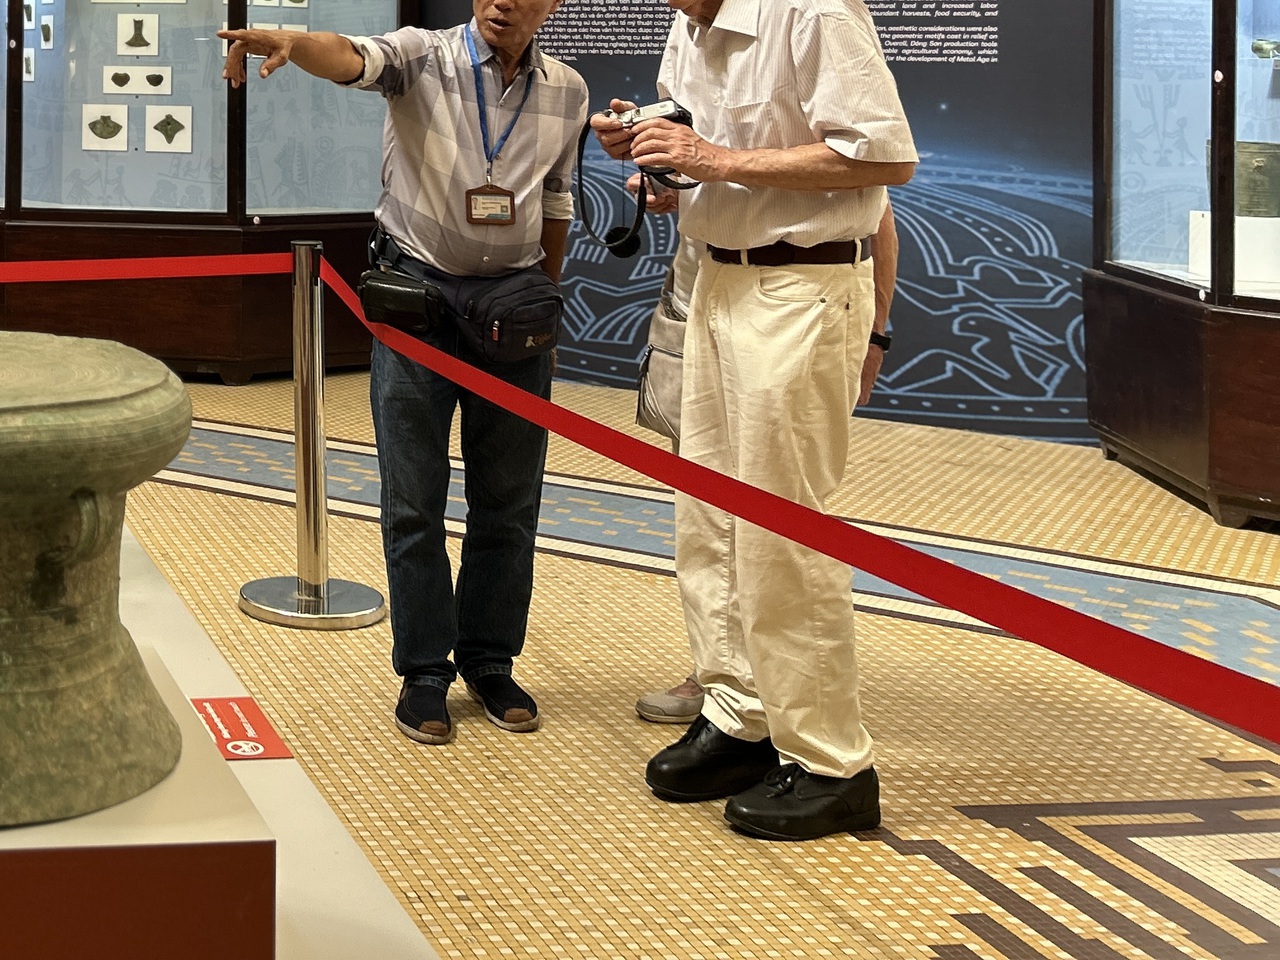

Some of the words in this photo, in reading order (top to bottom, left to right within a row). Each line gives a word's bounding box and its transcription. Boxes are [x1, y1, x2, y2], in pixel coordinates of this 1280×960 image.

[934, 10, 950, 18] food
[948, 55, 956, 63] of
[976, 56, 990, 64] Age
